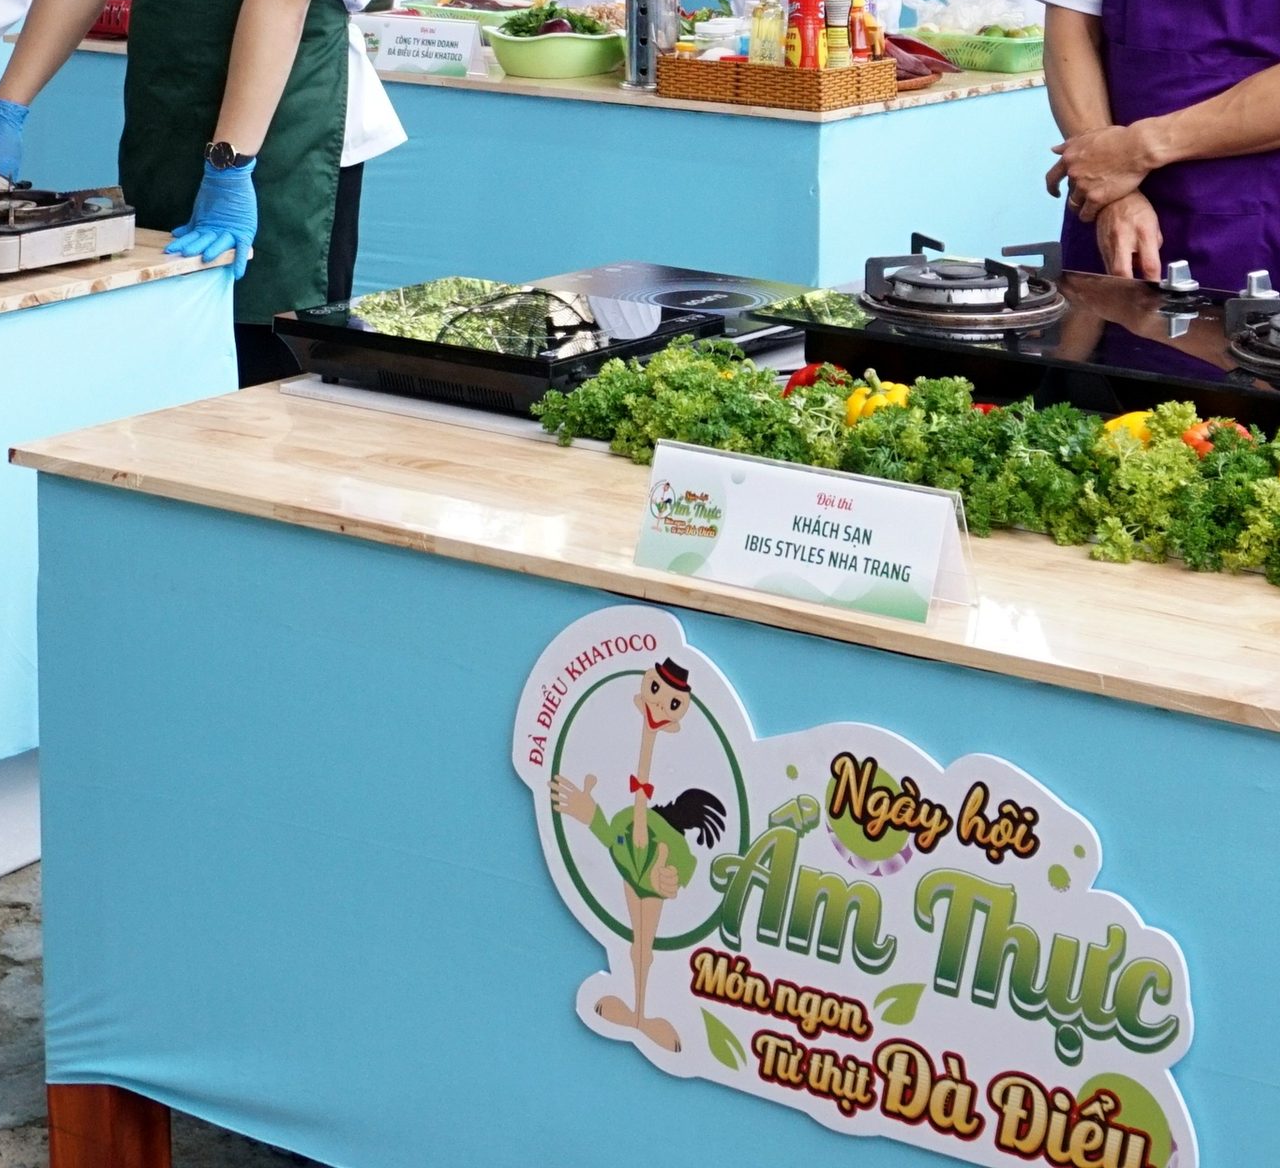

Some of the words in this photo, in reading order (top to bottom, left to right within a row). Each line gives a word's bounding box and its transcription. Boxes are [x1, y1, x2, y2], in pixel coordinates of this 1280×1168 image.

[395, 35, 412, 45] CÔNG
[413, 37, 420, 45] TY
[421, 38, 436, 47] KINH
[437, 39, 459, 48] DOANH
[434, 51, 463, 62] KHATOCO
[816, 491, 837, 512] Đội
[837, 495, 854, 512] thi
[793, 514, 840, 540] KHÁCH
[843, 524, 873, 550] SẠN
[744, 534, 771, 555] IBIS
[775, 539, 825, 567] STYLES
[827, 551, 859, 573] NHA
[863, 557, 912, 584] TRANG
[565, 633, 658, 682] KHATOCO
[536, 682, 570, 731] ĐIỂU
[528, 731, 548, 768] ĐÀ
[830, 751, 953, 855] Ngày
[957, 781, 1041, 864] hội
[710, 793, 898, 976] Ẩm
[914, 867, 1181, 1068] Thực
[690, 947, 772, 1012] Món
[772, 977, 874, 1042] ngon
[751, 1028, 807, 1087] Từ
[805, 1051, 879, 1118] thịt
[872, 1036, 986, 1141] Đà
[986, 1069, 1158, 1168] Điểu
